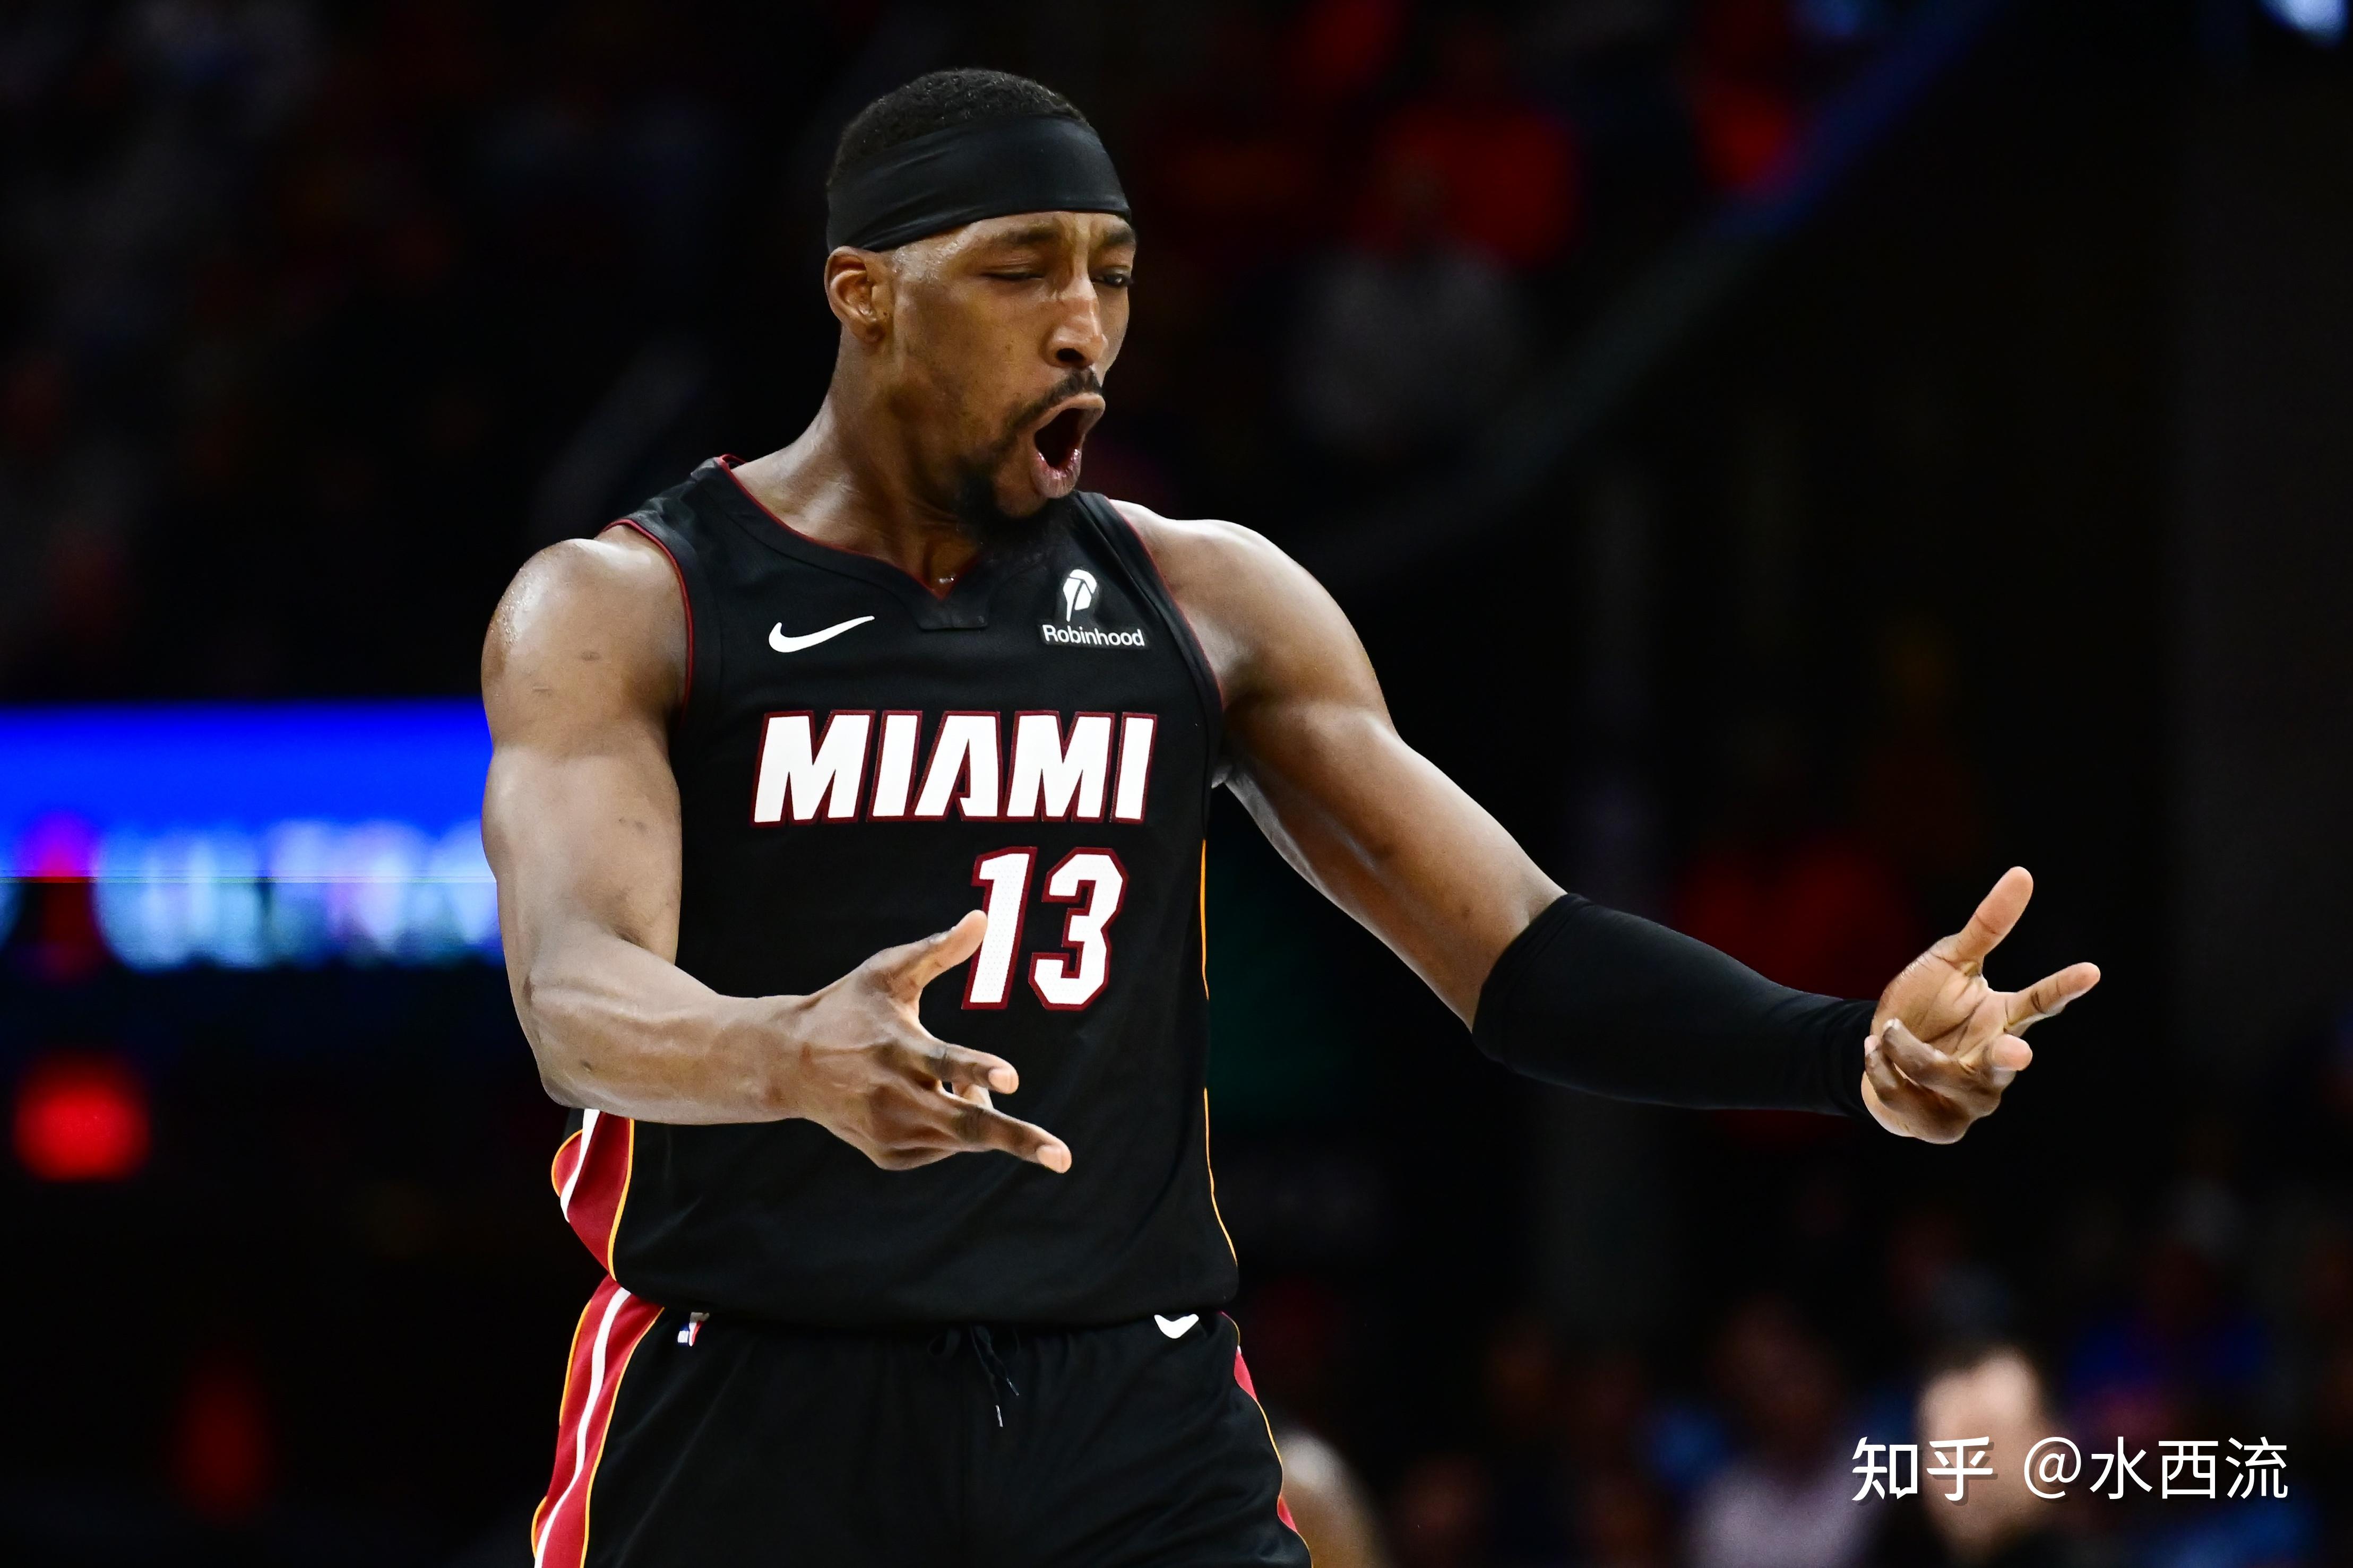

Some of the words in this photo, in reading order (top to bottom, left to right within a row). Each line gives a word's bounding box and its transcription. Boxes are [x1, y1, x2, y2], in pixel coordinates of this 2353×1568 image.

[1042, 624, 1145, 646] Robinhood
[750, 710, 1158, 825] MIAMI
[962, 846, 1129, 1011] 13
